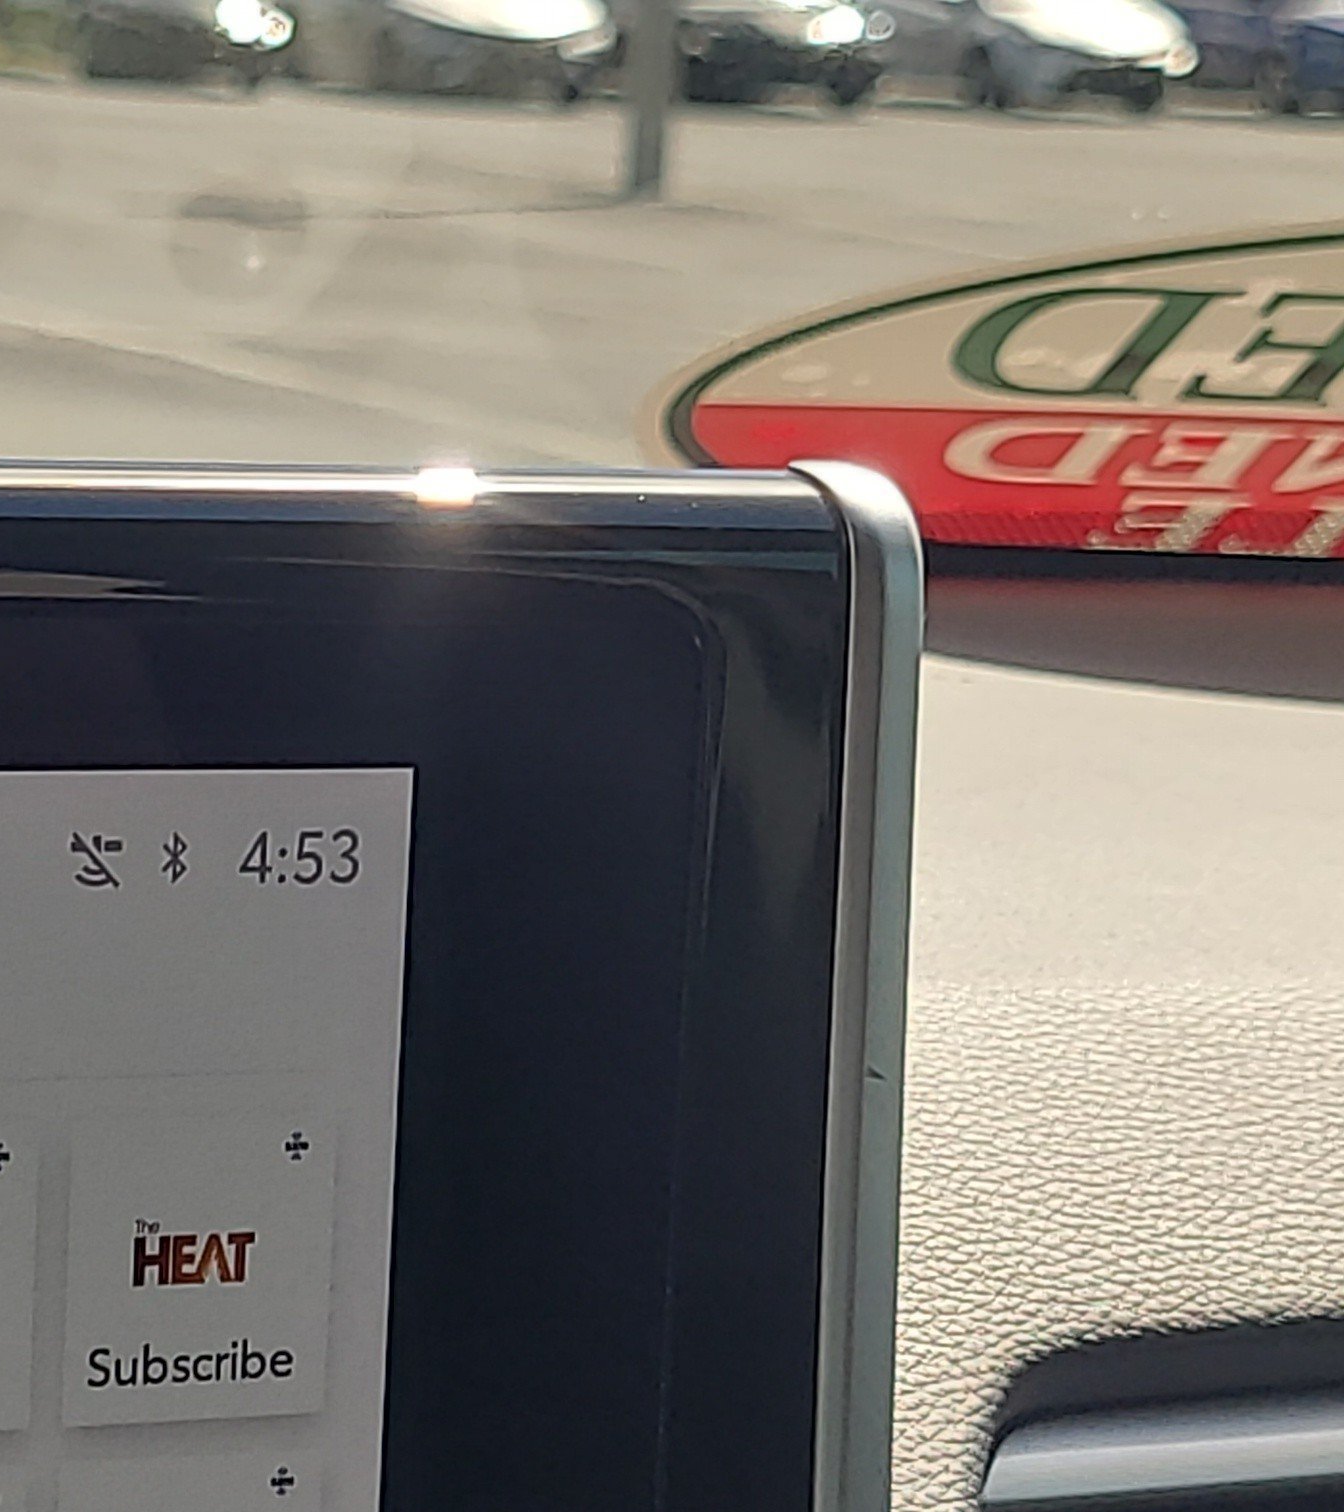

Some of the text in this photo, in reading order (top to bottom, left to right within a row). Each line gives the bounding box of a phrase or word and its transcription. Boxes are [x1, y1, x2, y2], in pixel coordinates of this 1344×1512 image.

[238, 828, 360, 886] 4:53
[132, 1231, 256, 1287] HEAT
[86, 1337, 295, 1389] Subscribe
